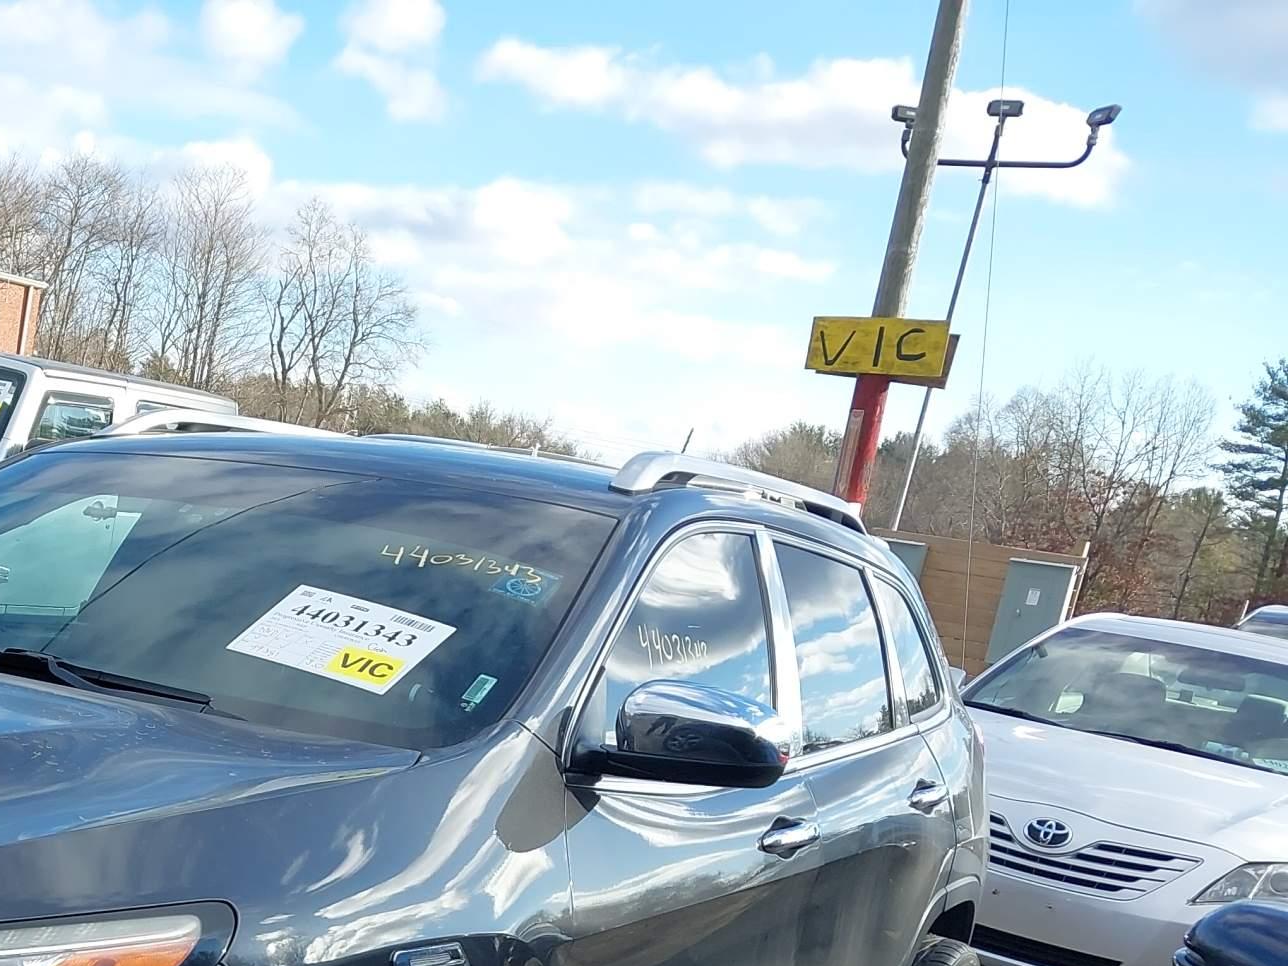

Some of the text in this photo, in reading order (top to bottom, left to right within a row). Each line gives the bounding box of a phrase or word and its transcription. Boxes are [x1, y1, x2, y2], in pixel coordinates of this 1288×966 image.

[820, 326, 926, 367] VIC
[381, 544, 542, 583] 44031343
[291, 604, 418, 647] 44031343
[340, 652, 394, 678] VIC
